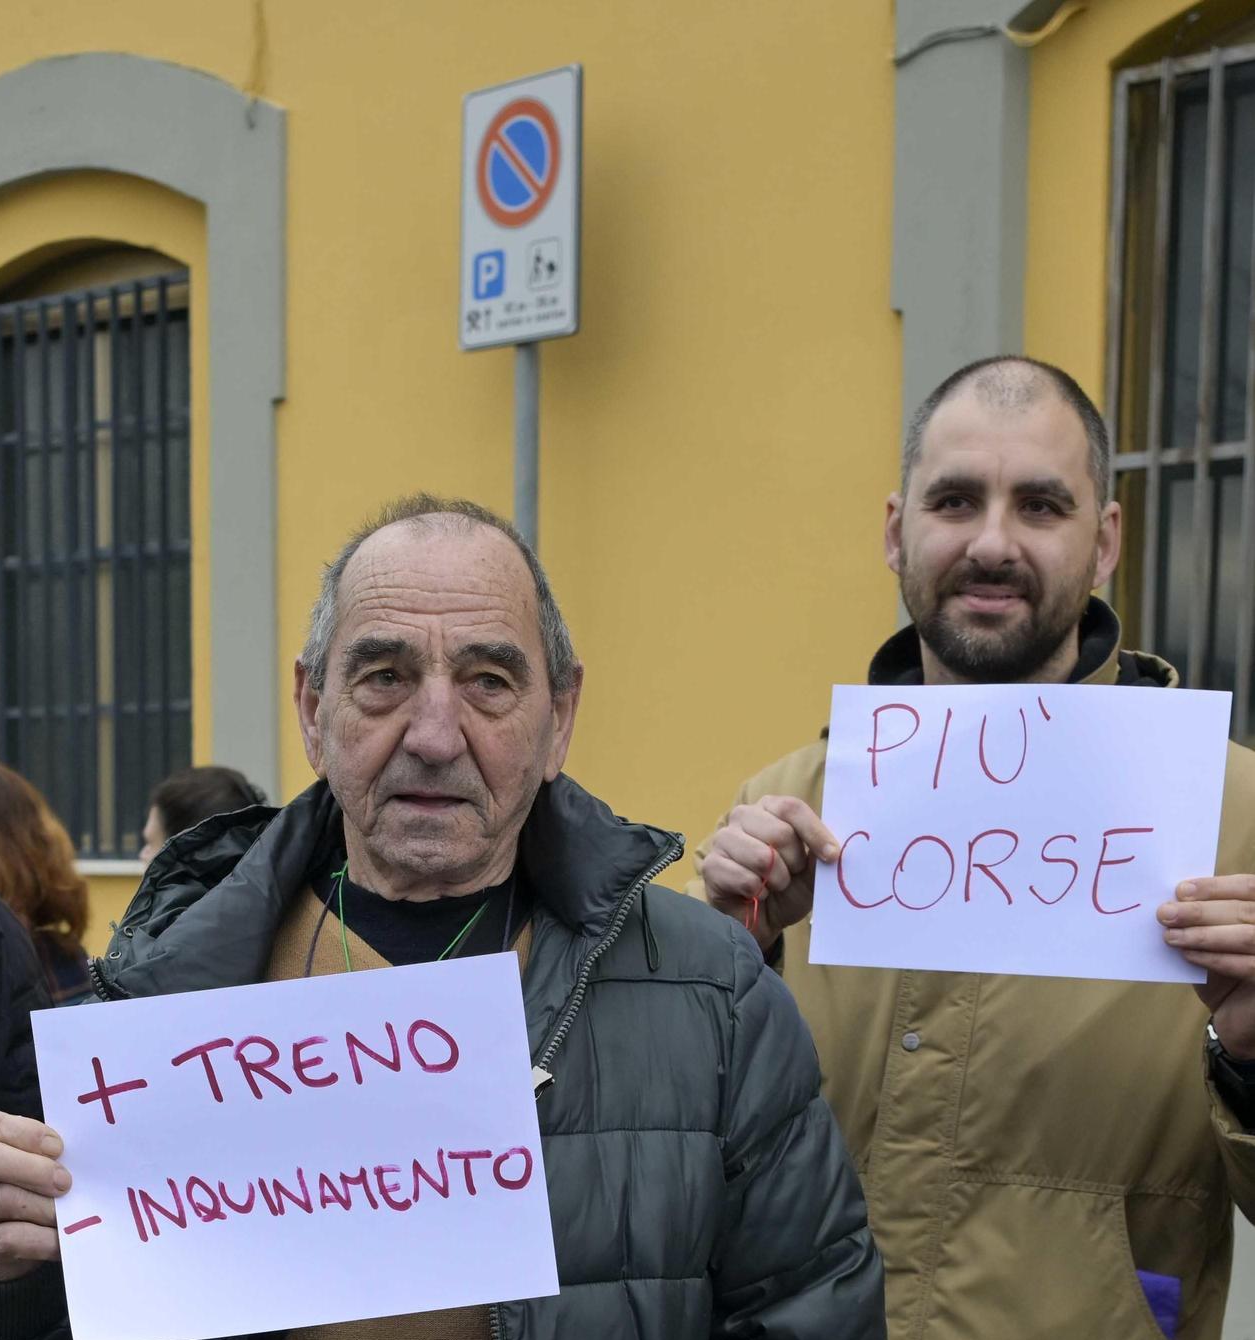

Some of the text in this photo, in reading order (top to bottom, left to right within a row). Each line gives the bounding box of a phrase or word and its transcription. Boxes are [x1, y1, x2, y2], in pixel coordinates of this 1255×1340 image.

[478, 257, 501, 298] P
[836, 827, 1154, 915] CORSE
[77, 1018, 460, 1125] + TRENO
[126, 1146, 534, 1243] INQUINAMENTO
